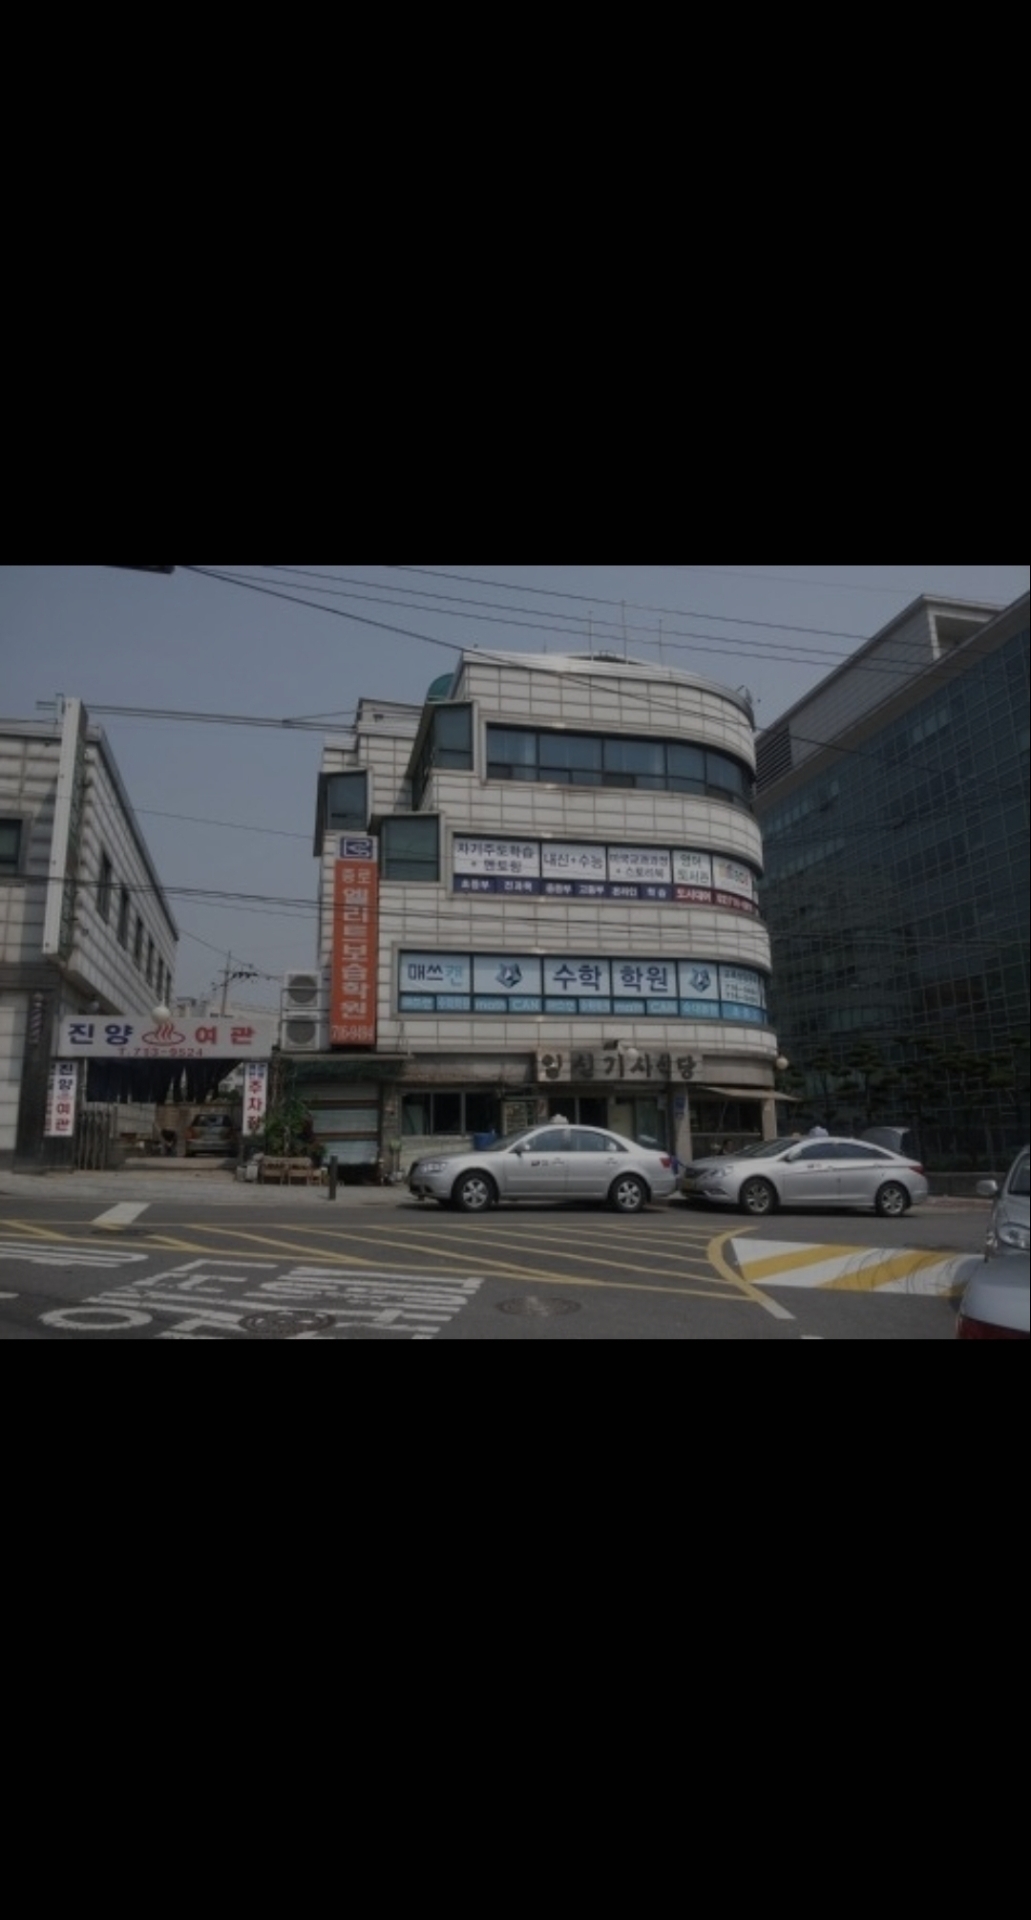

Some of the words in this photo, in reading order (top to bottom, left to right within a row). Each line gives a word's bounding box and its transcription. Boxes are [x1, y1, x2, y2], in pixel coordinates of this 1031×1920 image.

[457, 842, 535, 858] 자기주도학습
[484, 860, 522, 873] 멘토링
[680, 854, 702, 867] 영어
[677, 869, 709, 883] 도서관
[461, 879, 489, 890] 초등부
[504, 880, 533, 892] 전과목
[407, 963, 462, 987] 매쓰캔
[552, 963, 602, 991] 수학
[620, 965, 669, 993] 학원
[68, 1022, 133, 1046] 진양
[195, 1025, 256, 1045] 여관
